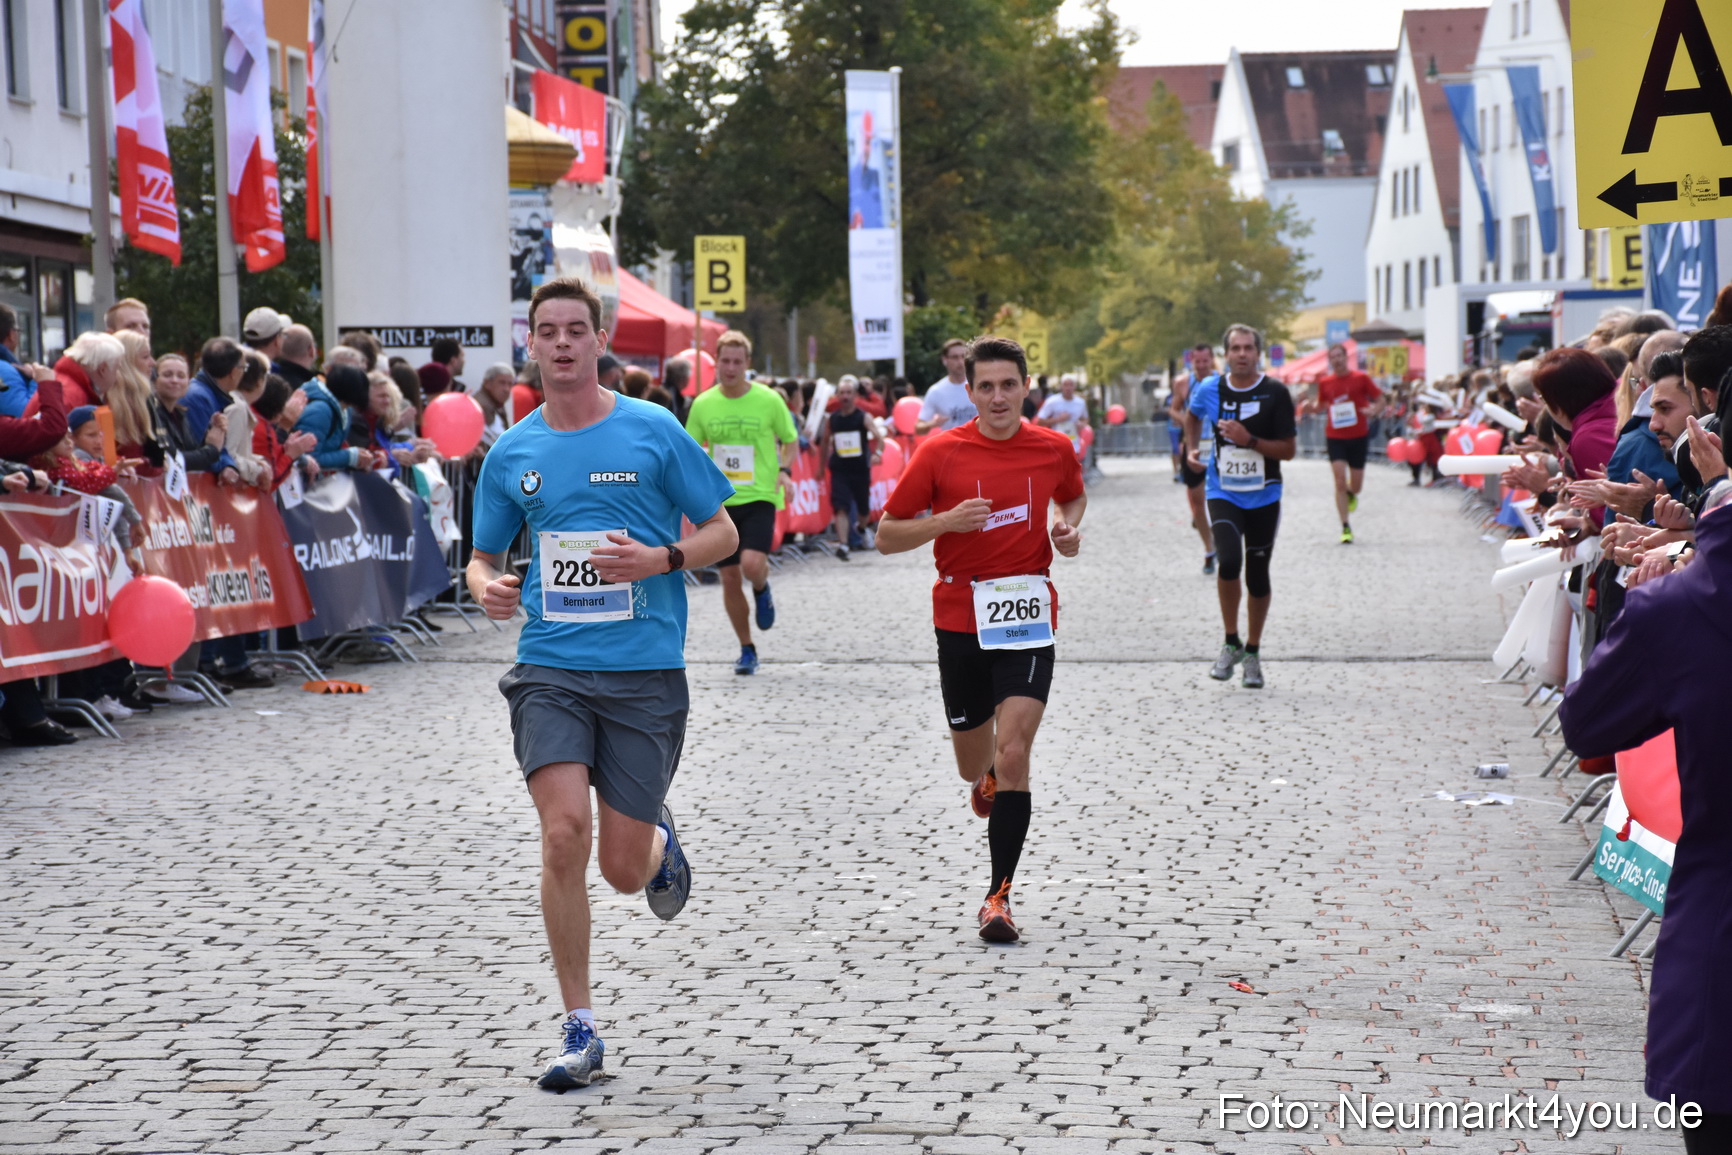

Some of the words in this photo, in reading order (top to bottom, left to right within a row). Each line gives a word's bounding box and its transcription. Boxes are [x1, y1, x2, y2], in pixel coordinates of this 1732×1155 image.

[1622, 0, 1732, 154] A
[700, 239, 737, 253] Block
[1625, 235, 1642, 271] E
[709, 260, 732, 294] B
[1026, 342, 1039, 362] C
[725, 457, 740, 469] 48
[1226, 461, 1257, 475] 2134
[589, 472, 639, 483] BOCK
[994, 512, 1016, 523] DEHN
[568, 540, 600, 549] BOCK
[553, 559, 616, 587] 228
[563, 596, 605, 607] Bernhard
[986, 598, 1040, 623] 2266
[1005, 629, 1029, 638] Stefan
